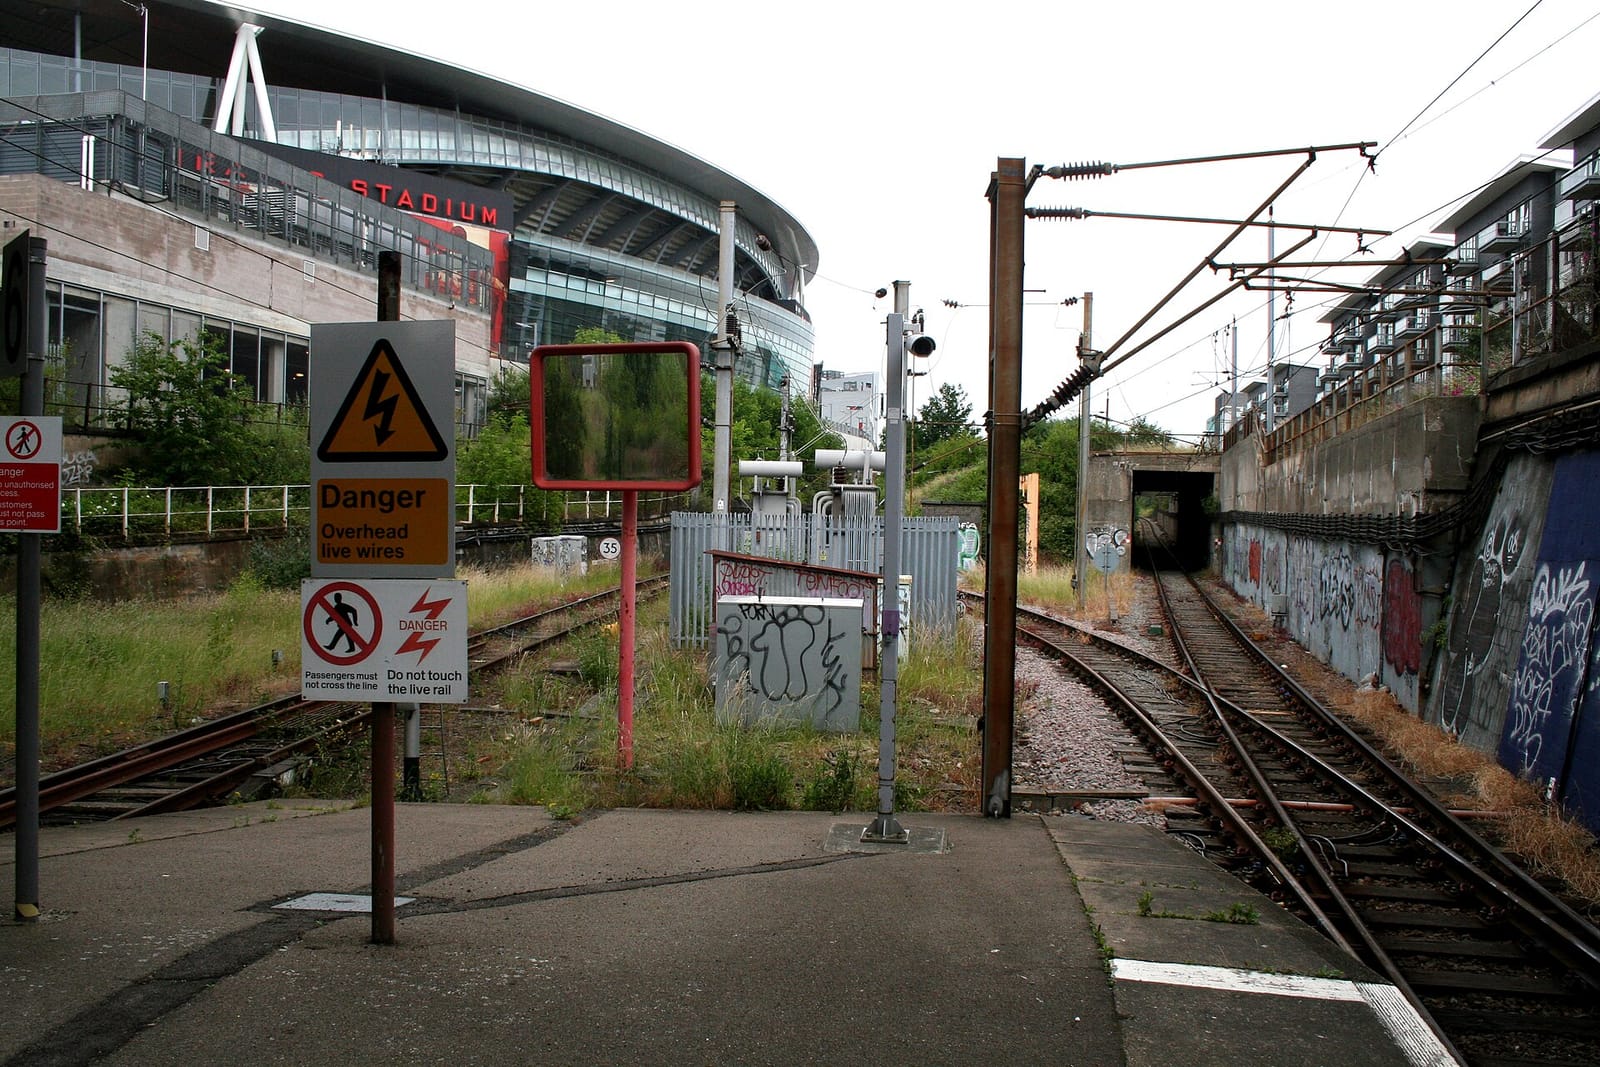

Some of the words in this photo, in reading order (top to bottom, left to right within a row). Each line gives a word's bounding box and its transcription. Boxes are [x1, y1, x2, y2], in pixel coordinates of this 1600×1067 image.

[351, 179, 497, 225] STADIUM
[0, 468, 24, 478] anger
[4, 481, 54, 490] unauthorised
[321, 484, 426, 514] Danger
[12, 510, 25, 518] not
[26, 511, 45, 519] pass
[321, 523, 409, 540] Overhead
[321, 543, 351, 559] live
[355, 543, 405, 559] wires
[603, 542, 618, 554] 35
[399, 620, 448, 631] DANGER
[305, 671, 355, 681] Passengers
[356, 672, 378, 681] must
[387, 669, 404, 681] Do
[406, 670, 426, 681] not
[428, 670, 462, 681] touch
[305, 681, 320, 689] not
[321, 682, 345, 690] cross
[346, 681, 361, 690] the
[362, 681, 378, 690] line
[388, 684, 407, 695] the
[409, 684, 431, 695] live
[433, 684, 452, 695] rail
